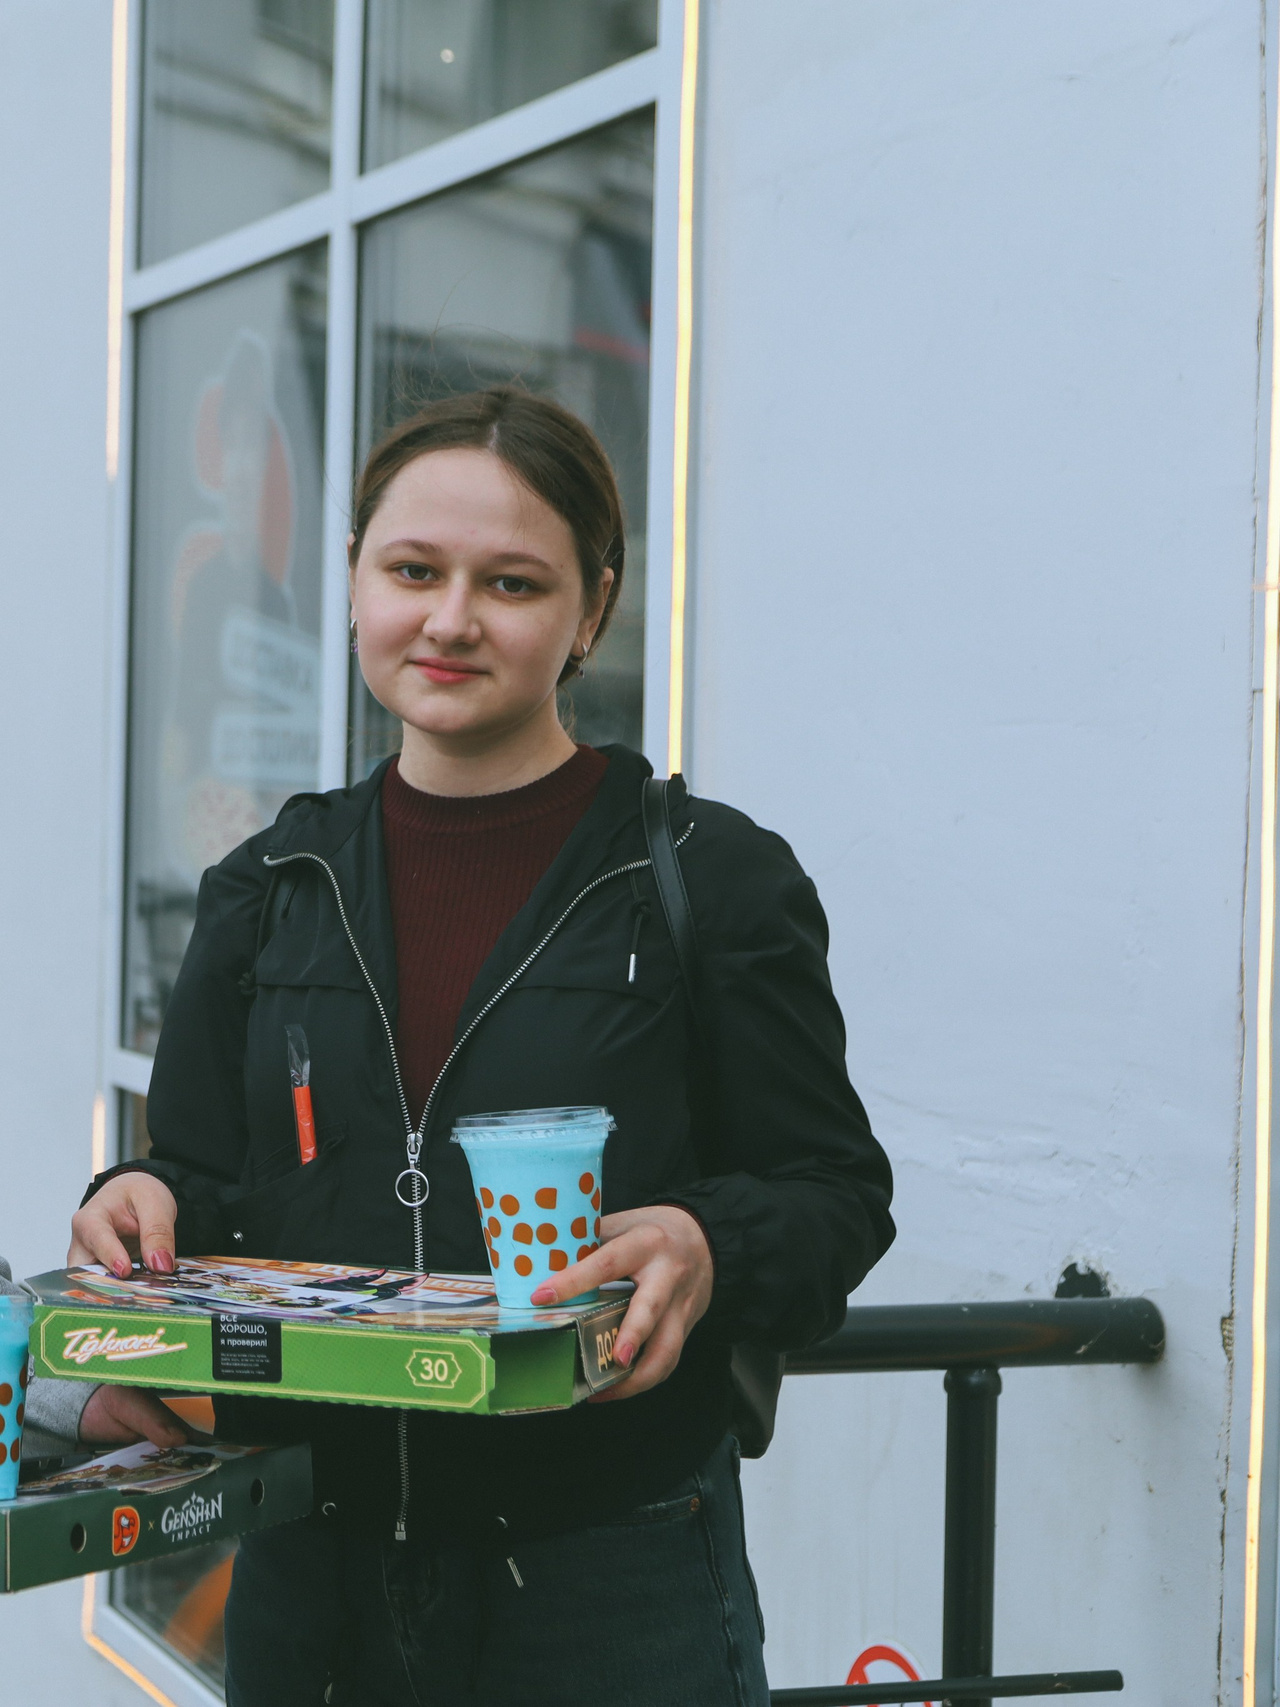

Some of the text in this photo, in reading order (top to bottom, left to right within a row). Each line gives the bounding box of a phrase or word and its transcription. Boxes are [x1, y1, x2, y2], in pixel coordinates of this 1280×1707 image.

[220, 1324, 268, 1335] ХОРОШО,
[63, 1327, 187, 1364] Tighnari
[227, 1339, 268, 1348] проверил!
[420, 1358, 448, 1382] 30
[171, 1523, 211, 1543] IMPACT
